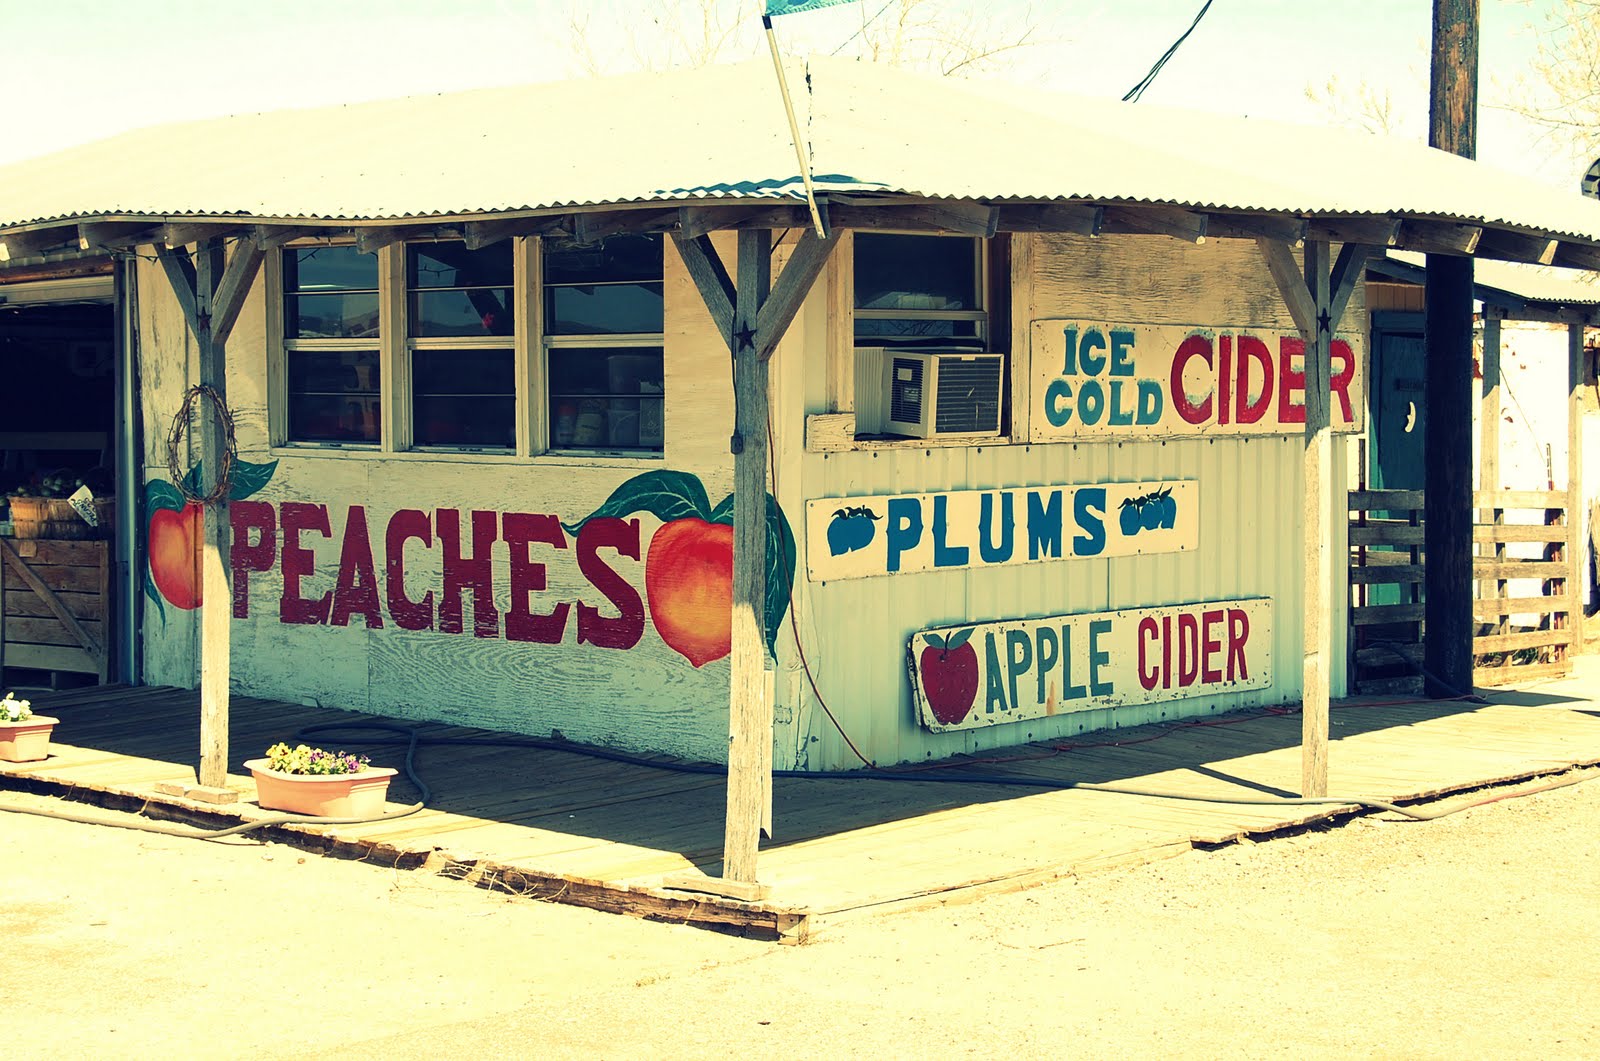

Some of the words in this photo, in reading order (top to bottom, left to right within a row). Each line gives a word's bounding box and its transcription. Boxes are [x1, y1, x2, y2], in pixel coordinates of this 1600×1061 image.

[1063, 325, 1136, 377] ICE
[1169, 332, 1356, 425] CIDER
[1044, 379, 1164, 427] COLD
[886, 487, 1108, 572] PLUMS
[230, 501, 645, 649] PEACHES
[985, 619, 1115, 715] APPLE
[1137, 609, 1250, 691] CIDER
